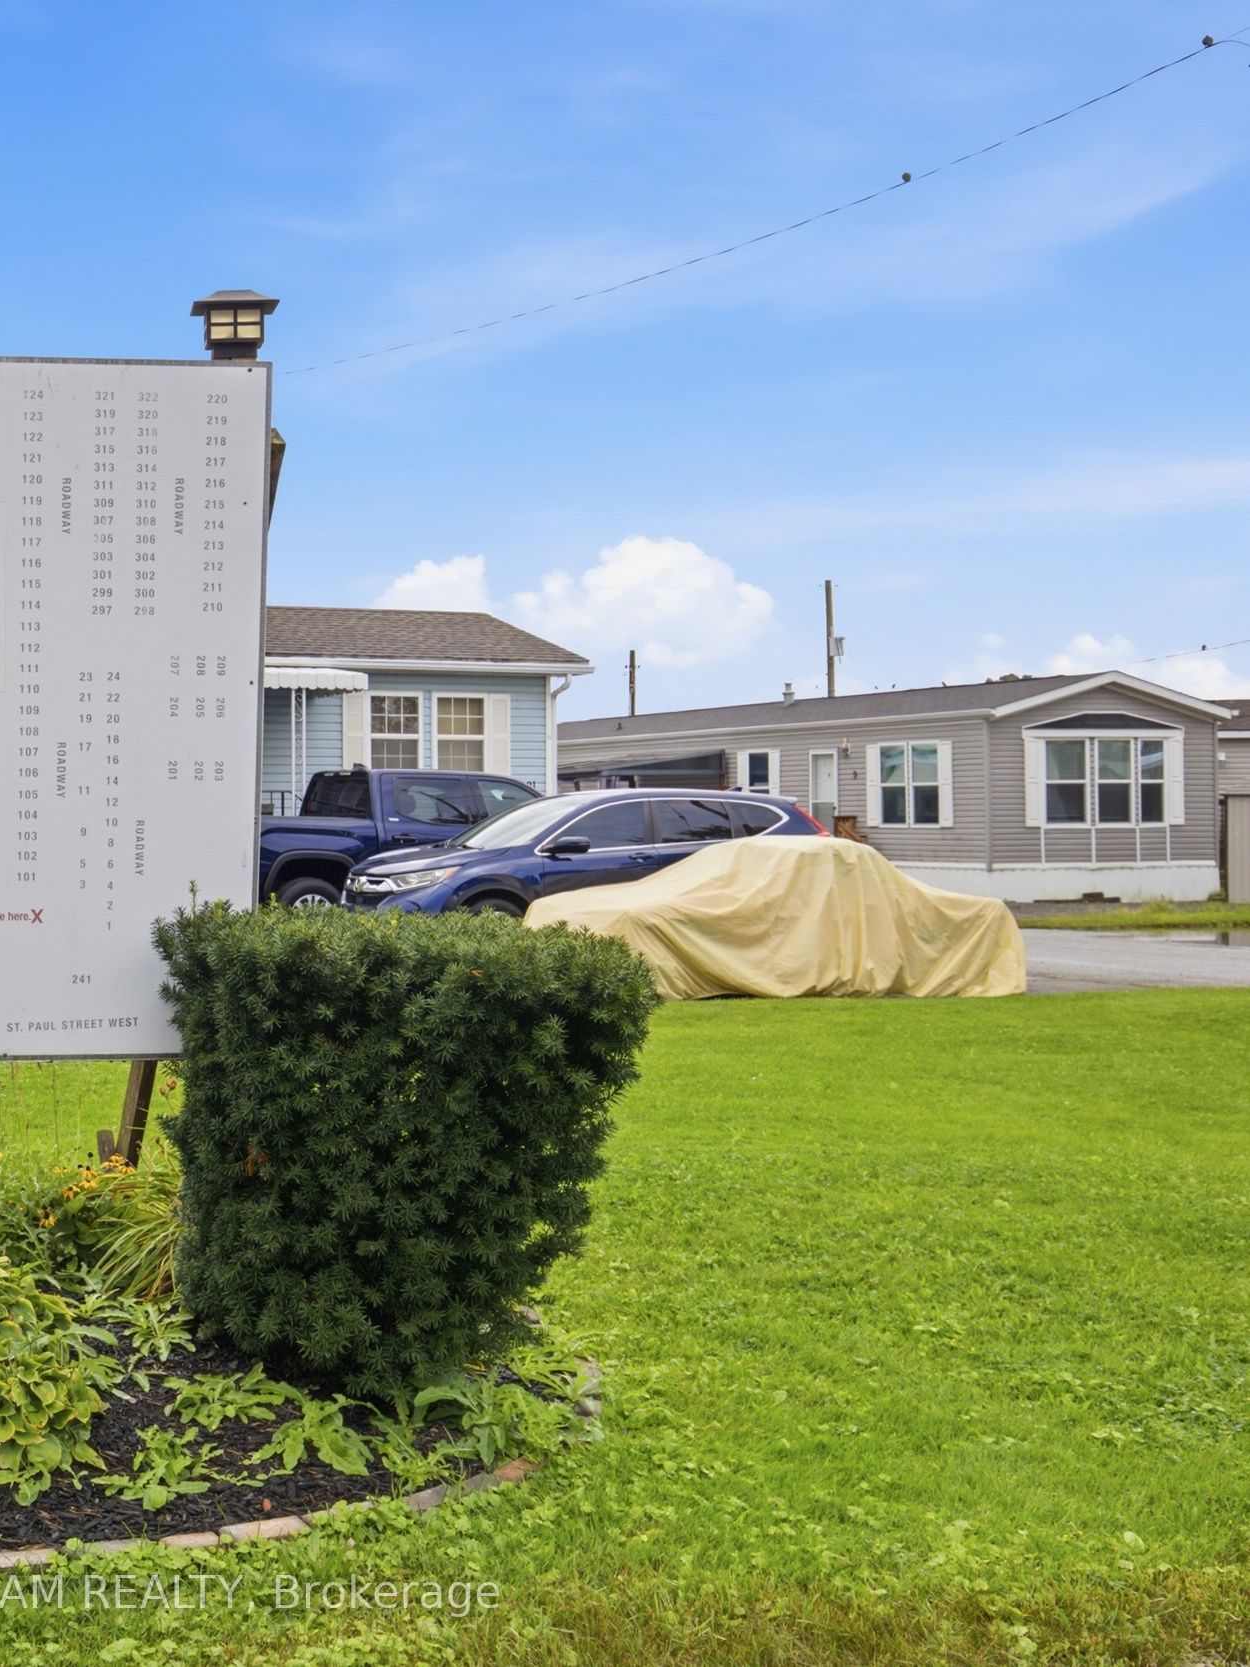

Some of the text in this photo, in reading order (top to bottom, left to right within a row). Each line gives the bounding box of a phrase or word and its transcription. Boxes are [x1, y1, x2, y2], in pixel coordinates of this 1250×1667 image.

[23, 389, 45, 401] 124
[95, 390, 115, 401] 321
[137, 391, 159, 403] 322
[207, 393, 228, 405] 220
[23, 410, 44, 422] 123
[94, 408, 116, 420] 319
[137, 409, 159, 420] 320
[206, 415, 228, 426] 219
[22, 431, 43, 443] 122
[94, 425, 116, 437] 317
[205, 435, 227, 447] 218
[94, 443, 115, 455] 315
[136, 444, 158, 456] 316
[22, 452, 42, 464] 121
[205, 456, 226, 468] 217
[93, 461, 115, 473] 313
[136, 462, 157, 474] 314
[21, 473, 43, 485] 120
[93, 479, 113, 491] 311
[204, 477, 226, 489] 216
[136, 480, 157, 492] 312
[21, 495, 43, 506] 119
[61, 477, 73, 535] ROADWAY
[93, 497, 115, 509] 309
[135, 498, 157, 510] 310
[173, 477, 186, 536] ROADWAY
[203, 499, 226, 510] 215
[21, 515, 43, 527] 118
[93, 514, 114, 526] 307
[135, 515, 157, 527] 308
[203, 519, 224, 531] 214
[21, 536, 42, 548] 117
[93, 532, 114, 544] 305
[135, 533, 157, 545] 306
[203, 540, 225, 551] 213
[92, 551, 114, 562] 303
[134, 552, 156, 563] 304
[21, 557, 42, 569] 116
[202, 561, 224, 572] 212
[91, 568, 112, 580] 301
[134, 570, 156, 581] 302
[21, 578, 42, 589] 115
[202, 581, 222, 593] 211
[91, 587, 113, 598] 299
[134, 587, 156, 599] 300
[20, 599, 41, 610] 114
[91, 604, 113, 617] 297
[134, 605, 155, 616] 298
[202, 601, 223, 613] 210
[20, 621, 42, 632] 113
[19, 642, 41, 653] 112
[19, 663, 39, 674] 111
[169, 655, 181, 676] 207
[195, 655, 207, 677] 208
[216, 655, 227, 677] 209
[78, 671, 94, 682] 23
[106, 671, 121, 682] 24
[19, 683, 40, 695] 110
[78, 691, 92, 703] 21
[106, 692, 121, 703] 22
[18, 704, 40, 716] 109
[169, 696, 180, 718] 204
[195, 696, 206, 719] 205
[215, 697, 226, 719] 206
[79, 713, 93, 724] 19
[106, 713, 120, 724] 20
[18, 726, 40, 737] 108
[106, 734, 120, 745] 18
[18, 746, 39, 758] 107
[78, 741, 92, 752] 17
[106, 754, 120, 766] 16
[18, 767, 39, 778] 106
[55, 741, 67, 799] ROADWAY
[167, 760, 179, 780] 201
[193, 760, 205, 782] 202
[214, 760, 225, 782] 203
[105, 775, 119, 786] 14
[18, 789, 39, 800] 105
[77, 785, 91, 796] 11
[105, 796, 119, 808] 12
[17, 809, 38, 821] 104
[105, 817, 119, 828] 10
[16, 830, 38, 842] 103
[79, 826, 87, 837] 9
[107, 837, 115, 848] 8
[134, 819, 146, 877] ROADWAY
[16, 849, 38, 862] 102
[79, 858, 87, 869] 5
[107, 858, 115, 870] 6
[16, 871, 36, 882] 101
[79, 879, 86, 890] 3
[106, 880, 114, 891] 4
[106, 900, 114, 911] 2
[7, 911, 32, 922] here.
[106, 921, 112, 931] 1
[71, 974, 91, 985] 241
[5, 1016, 139, 1033] ST. PAUL STREET WEST
